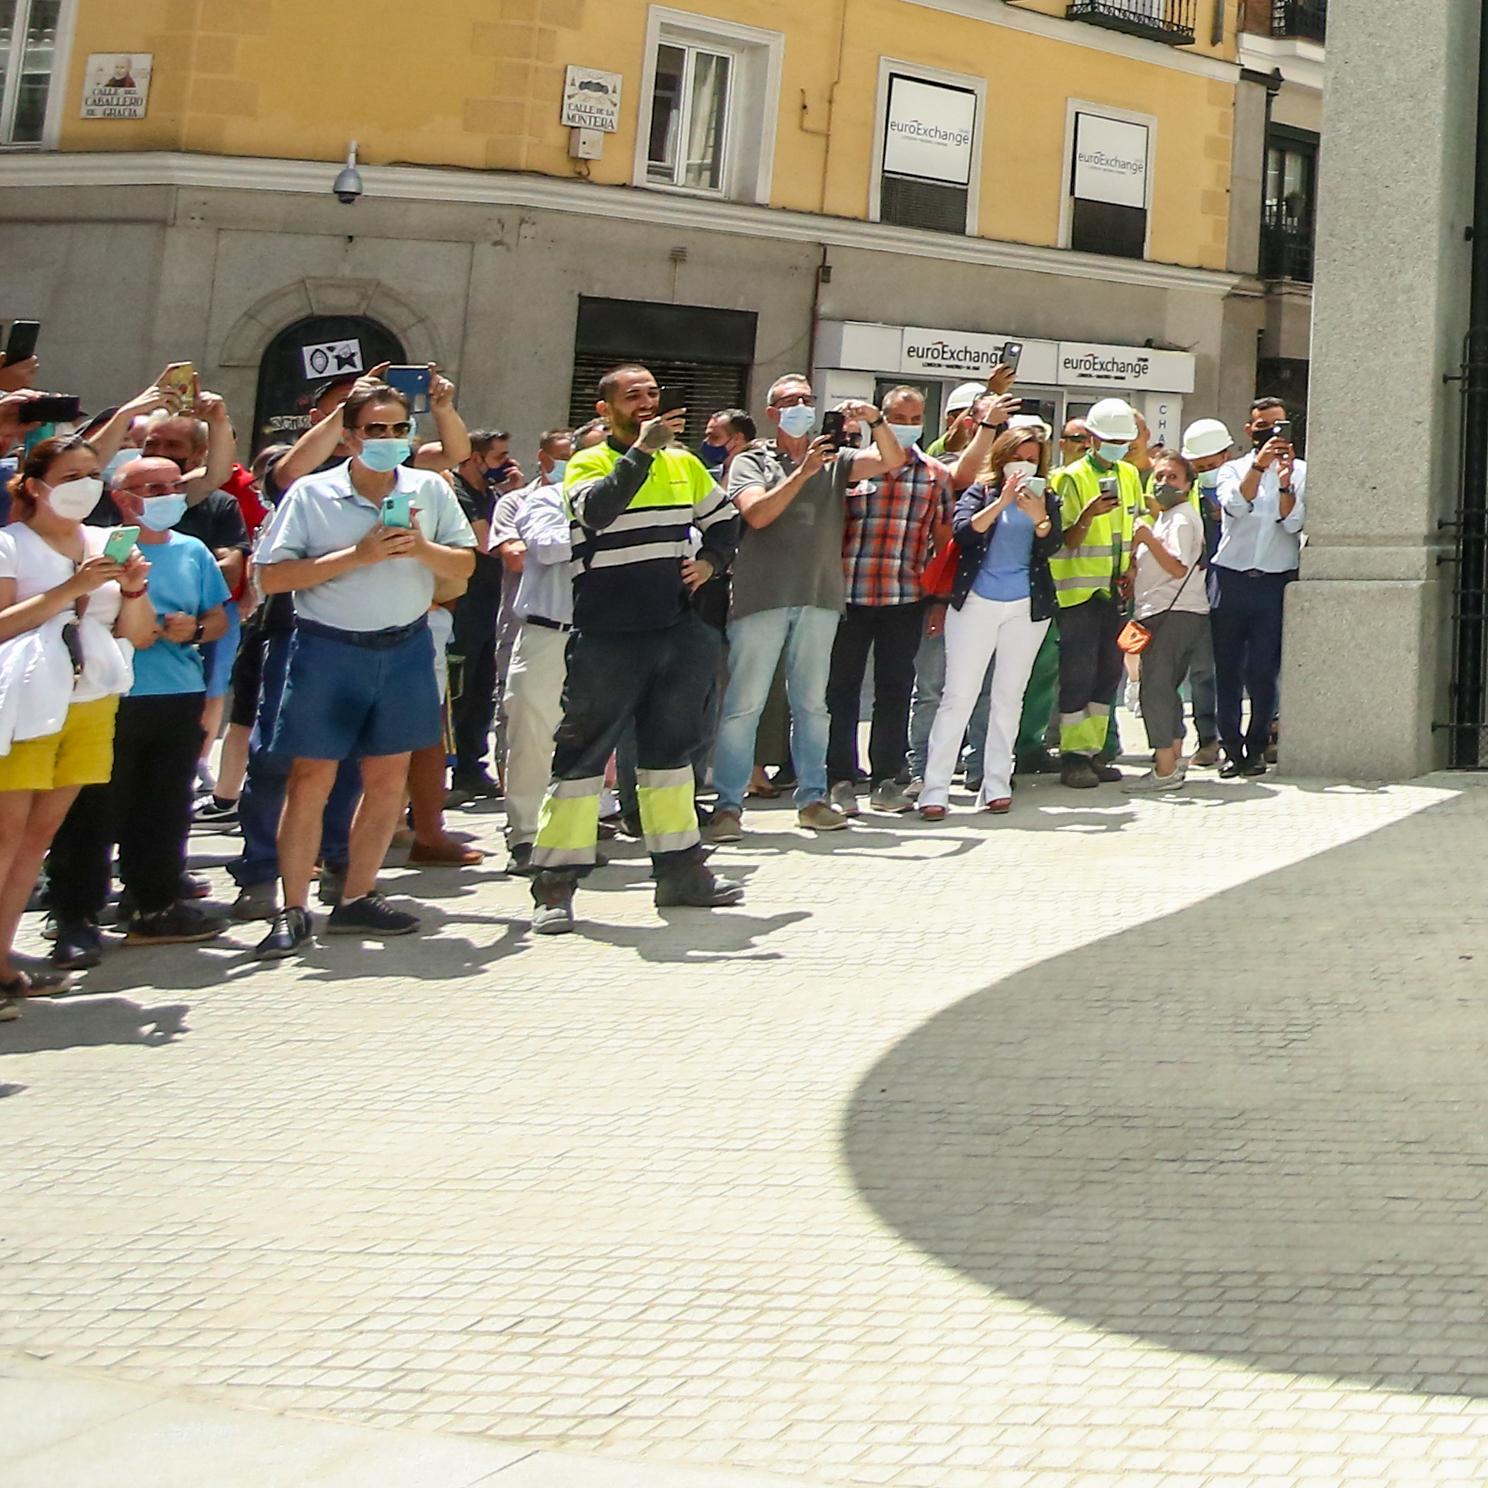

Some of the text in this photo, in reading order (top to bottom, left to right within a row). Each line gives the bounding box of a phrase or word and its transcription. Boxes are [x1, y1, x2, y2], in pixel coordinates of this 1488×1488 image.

[93, 87, 118, 95] CALLE
[85, 97, 144, 108] CABALLERO
[568, 102, 595, 115] CALLE
[102, 107, 138, 118] GRACIA
[566, 112, 615, 130] MONTERA
[889, 120, 970, 147] euroExchange
[1078, 152, 1144, 175] euroExchange
[1063, 355, 1149, 379] euroExchange
